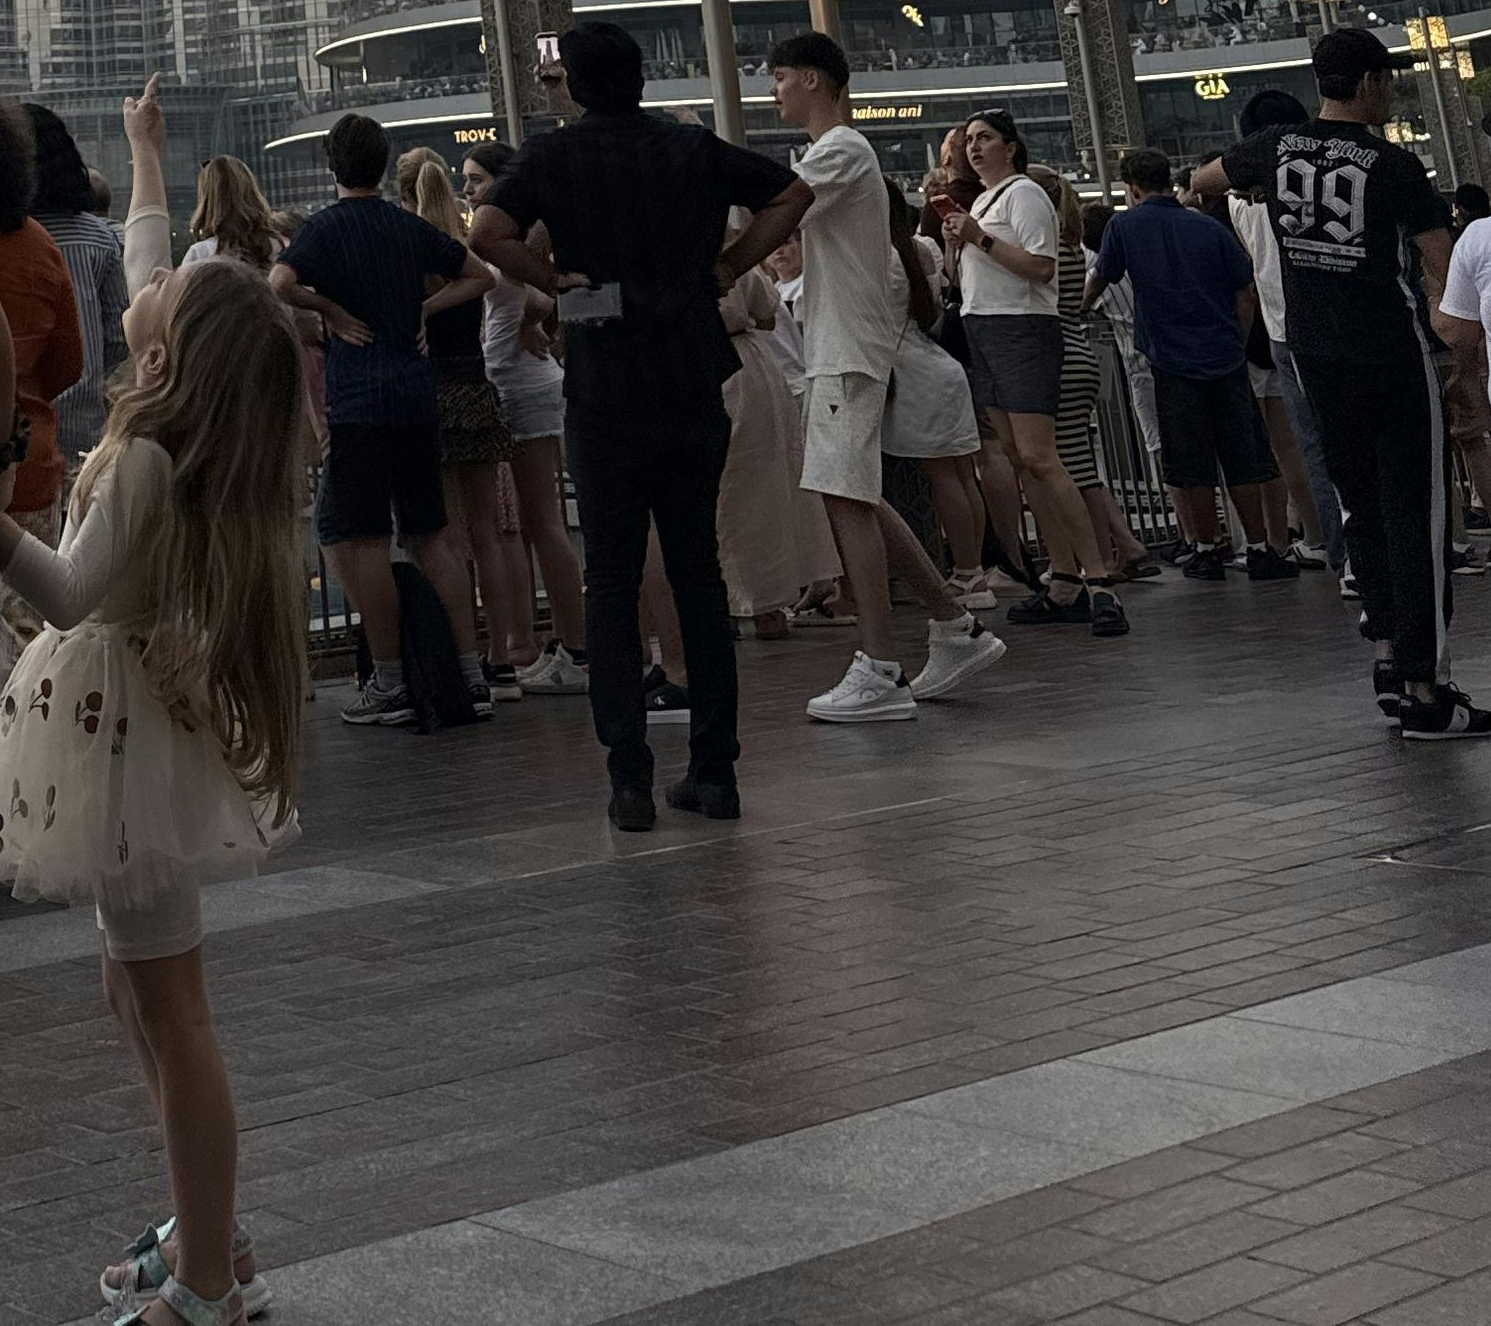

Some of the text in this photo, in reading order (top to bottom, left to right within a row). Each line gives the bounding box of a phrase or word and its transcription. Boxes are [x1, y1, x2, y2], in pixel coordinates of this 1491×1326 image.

[1195, 78, 1230, 96] GIA
[1276, 134, 1379, 168] New York
[1276, 158, 1368, 244] 99
